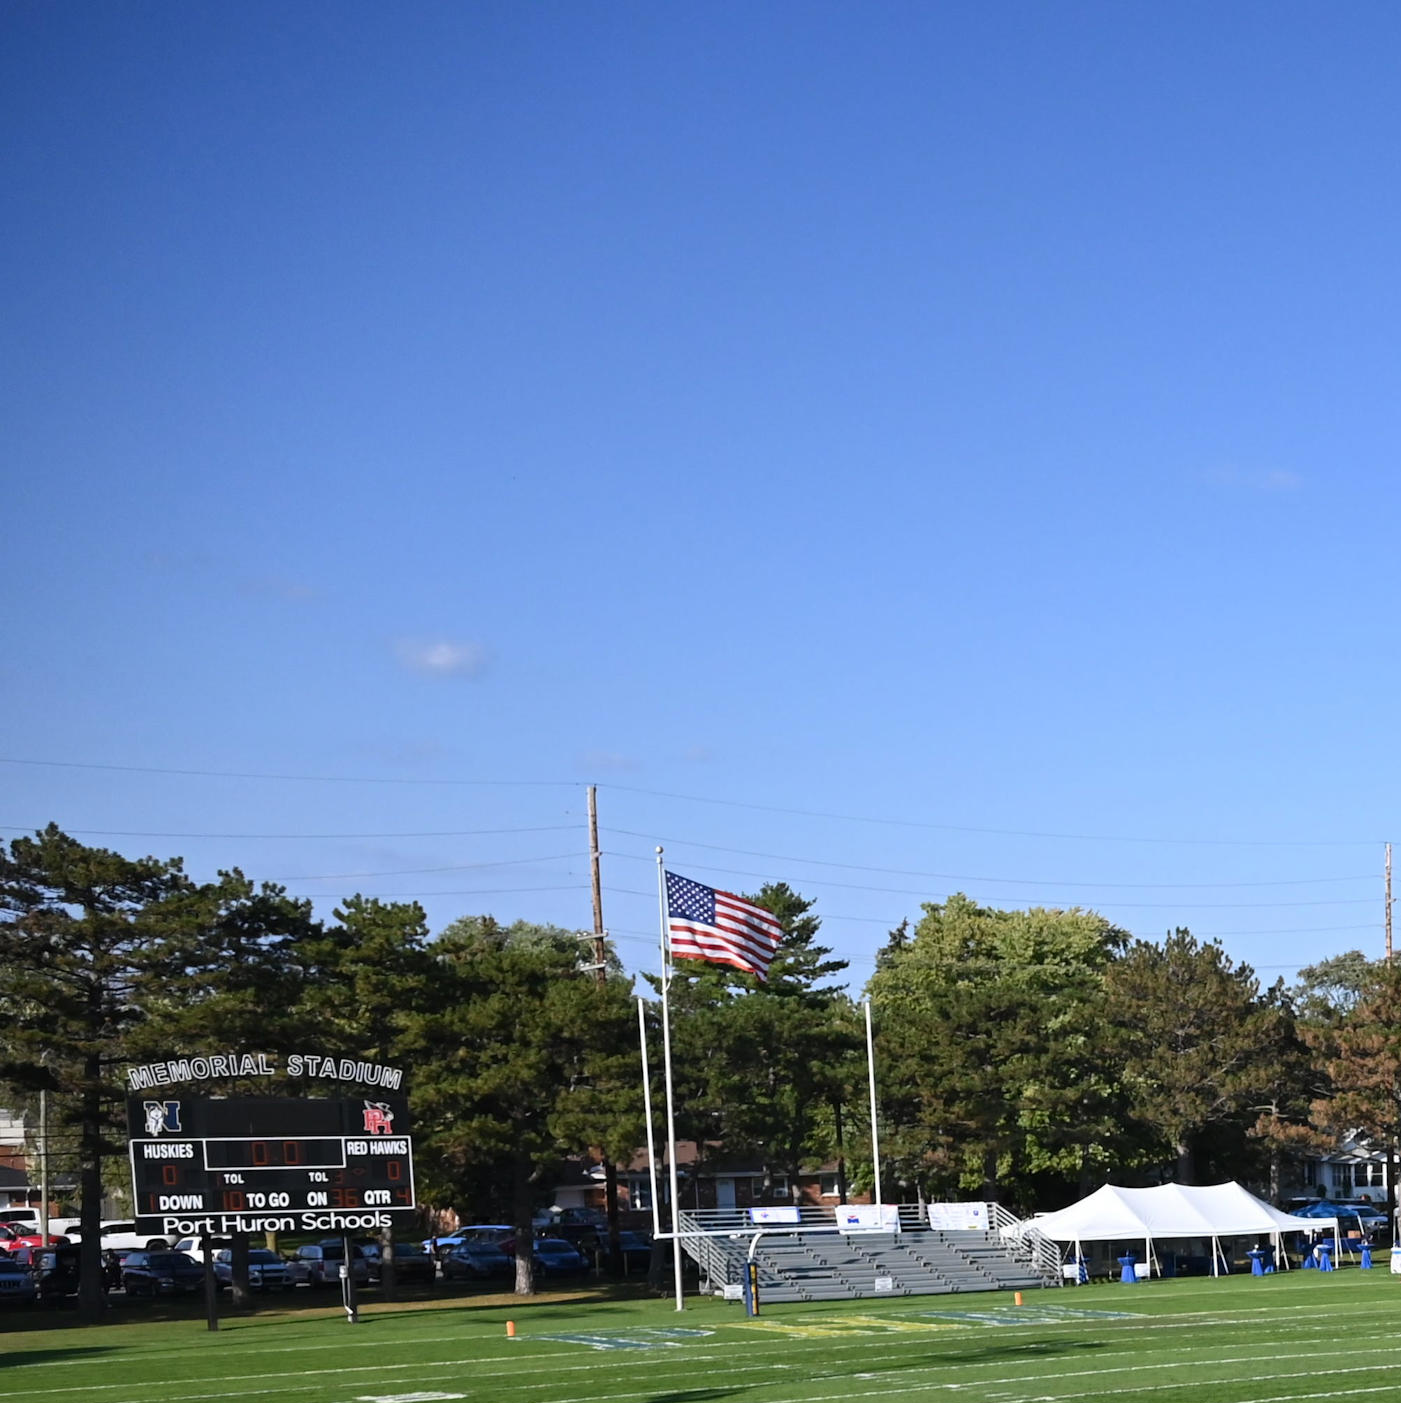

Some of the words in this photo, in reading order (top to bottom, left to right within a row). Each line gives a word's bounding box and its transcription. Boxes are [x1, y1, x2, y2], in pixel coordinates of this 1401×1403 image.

[127, 1054, 275, 1090] MEMORIAL
[286, 1055, 403, 1090] STADIUM
[143, 1143, 194, 1159] HUSKIES
[346, 1141, 367, 1155] RED
[370, 1140, 408, 1155] HAWKS
[223, 1173, 245, 1184] TOL
[308, 1171, 329, 1182] TOL
[158, 1195, 203, 1211] DOWN
[246, 1192, 267, 1209] TO
[268, 1191, 290, 1208] GO
[306, 1191, 328, 1207] ON
[364, 1189, 392, 1206] QTR
[163, 1217, 215, 1235] Port
[221, 1214, 295, 1233] Huron
[301, 1211, 393, 1230] Schools
